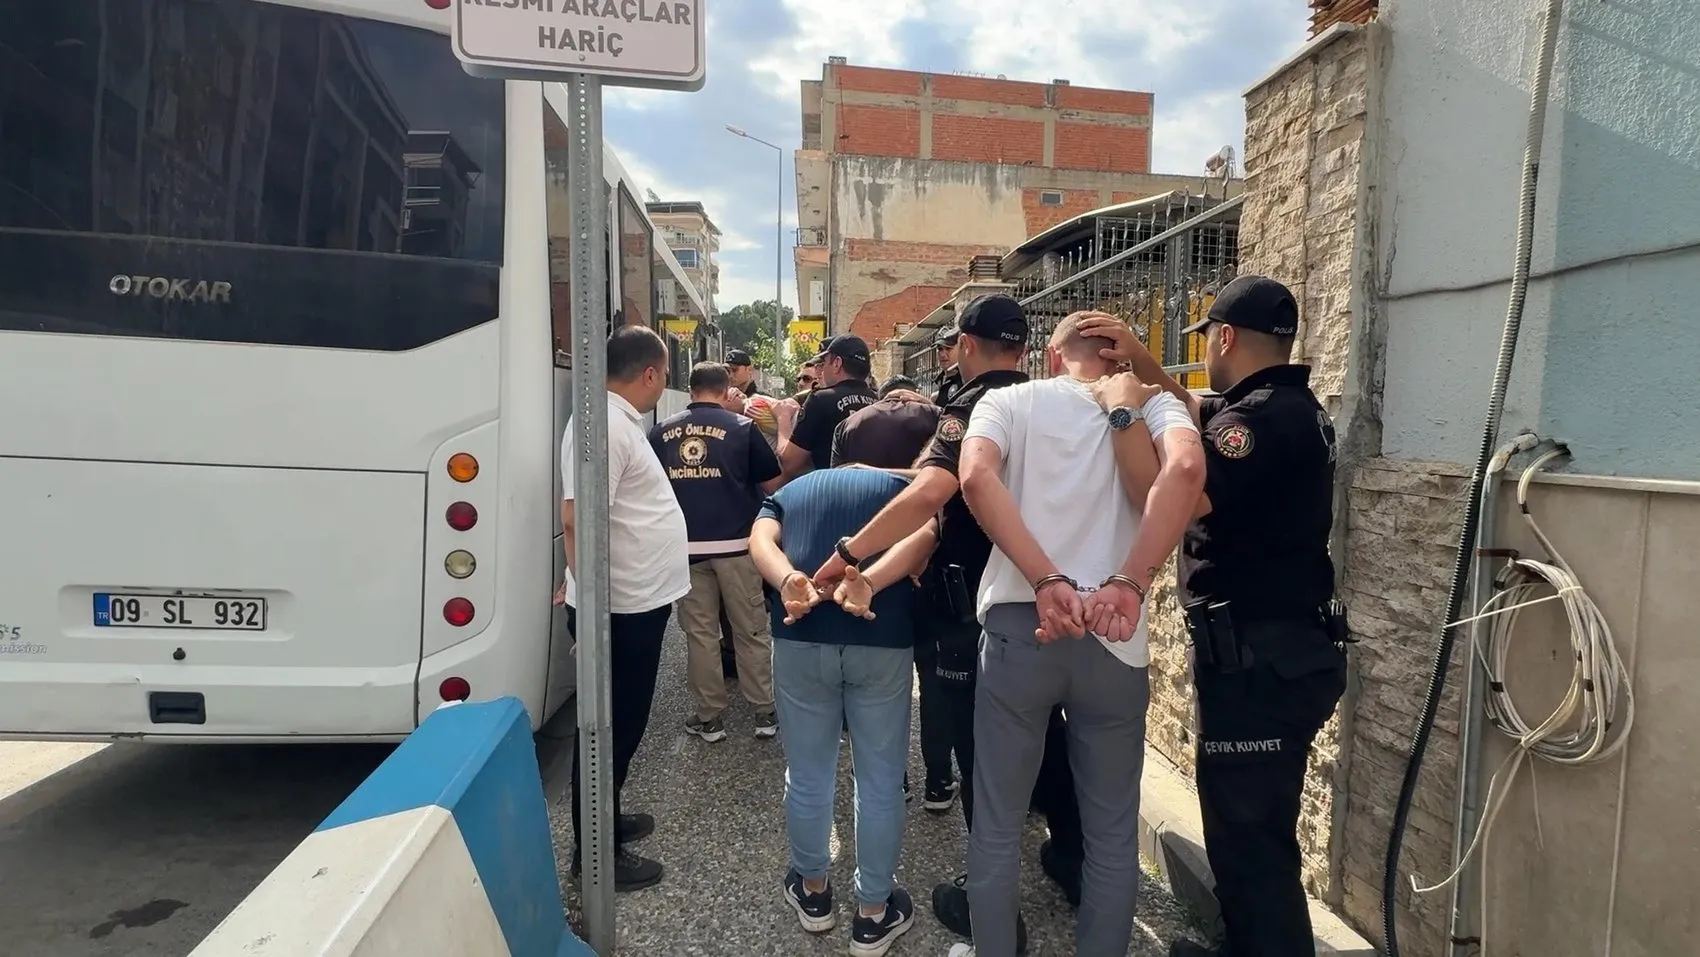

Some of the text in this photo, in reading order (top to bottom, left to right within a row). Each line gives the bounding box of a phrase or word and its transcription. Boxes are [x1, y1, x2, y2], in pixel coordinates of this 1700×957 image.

[561, 0, 691, 26] ARAÇLAR
[538, 26, 623, 57] HARİÇ
[109, 274, 232, 303] OTOKAR
[662, 423, 727, 442] SUÇ ÖNLEME
[98, 611, 109, 619] TR
[111, 598, 259, 626] 09 SL 932
